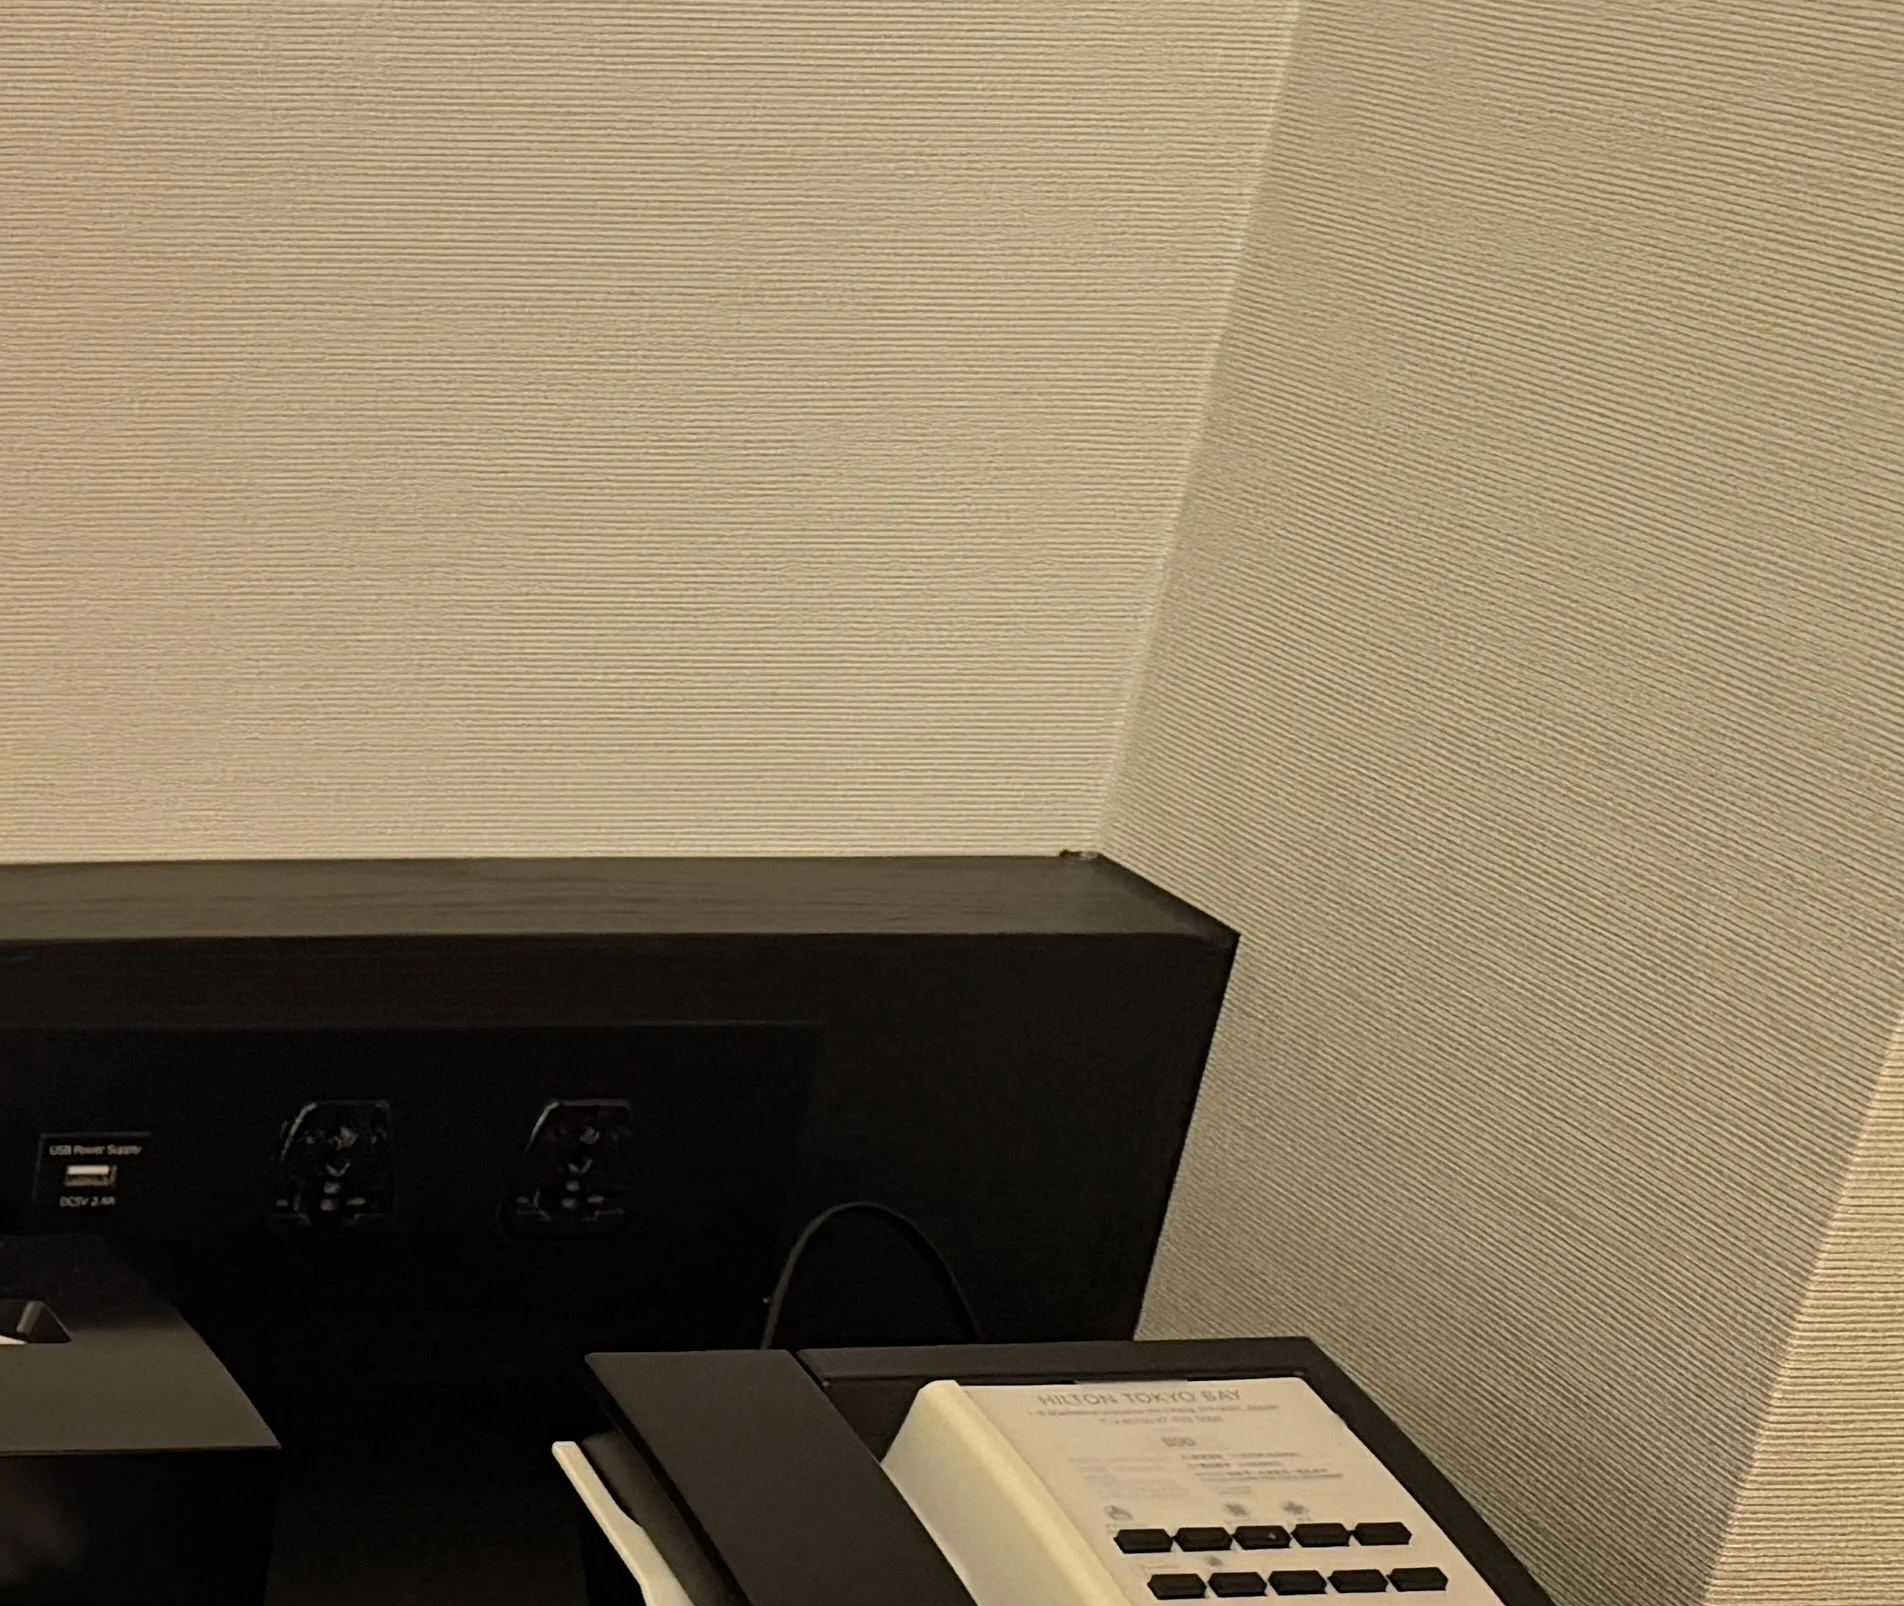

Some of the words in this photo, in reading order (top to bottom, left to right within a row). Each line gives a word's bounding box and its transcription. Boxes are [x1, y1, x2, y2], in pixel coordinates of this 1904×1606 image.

[107, 1144, 142, 1156] Supply
[1038, 1394, 1118, 1405] HILTON
[1122, 1391, 1196, 1404] TOKYO
[1201, 1389, 1240, 1402] BAY
